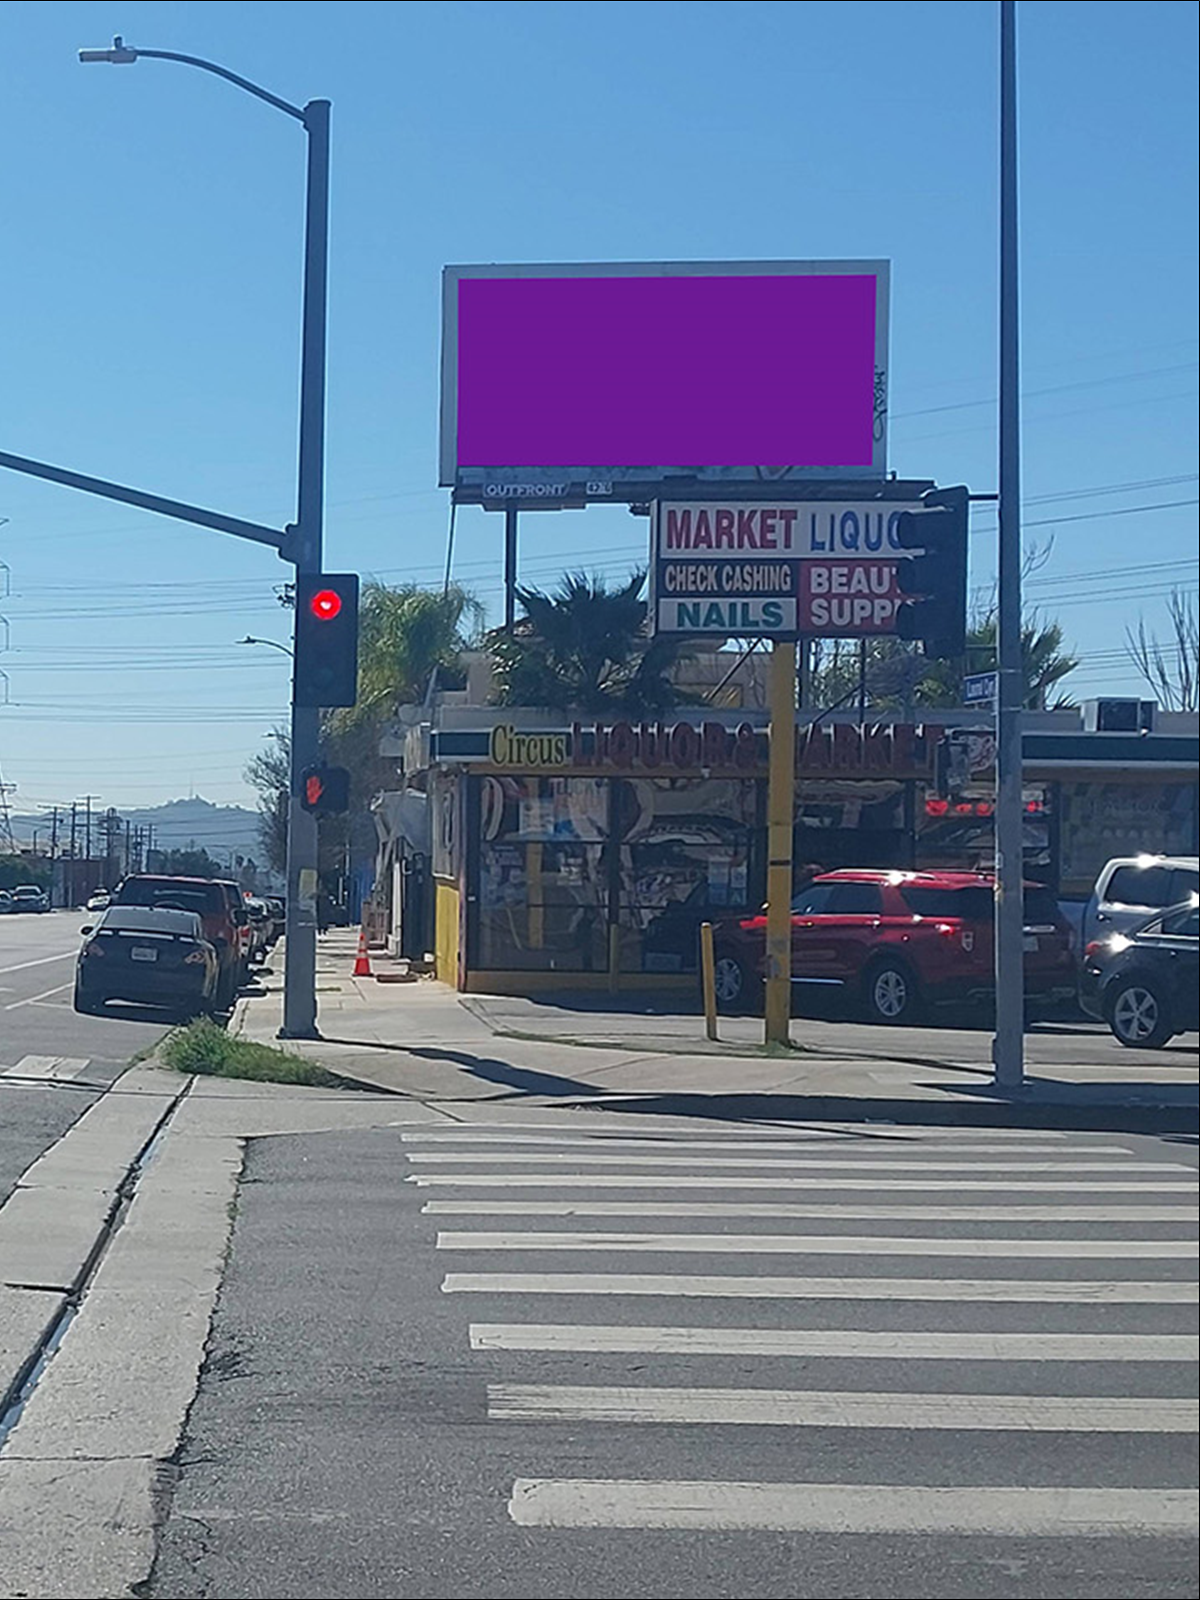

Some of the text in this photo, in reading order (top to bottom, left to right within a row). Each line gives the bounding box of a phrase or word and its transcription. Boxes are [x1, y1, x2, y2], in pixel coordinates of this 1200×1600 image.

[487, 484, 565, 496] OUTFRONT
[666, 509, 798, 549] MARKET
[810, 511, 902, 552] LIQUO
[664, 565, 792, 592] CHECK CASHING
[810, 567, 901, 594] BEAU
[676, 602, 784, 628] NAILS
[810, 599, 900, 627] SUPP
[492, 725, 564, 764] Circus
[571, 722, 728, 769] LIQUOR
[768, 723, 947, 770] ARKET
